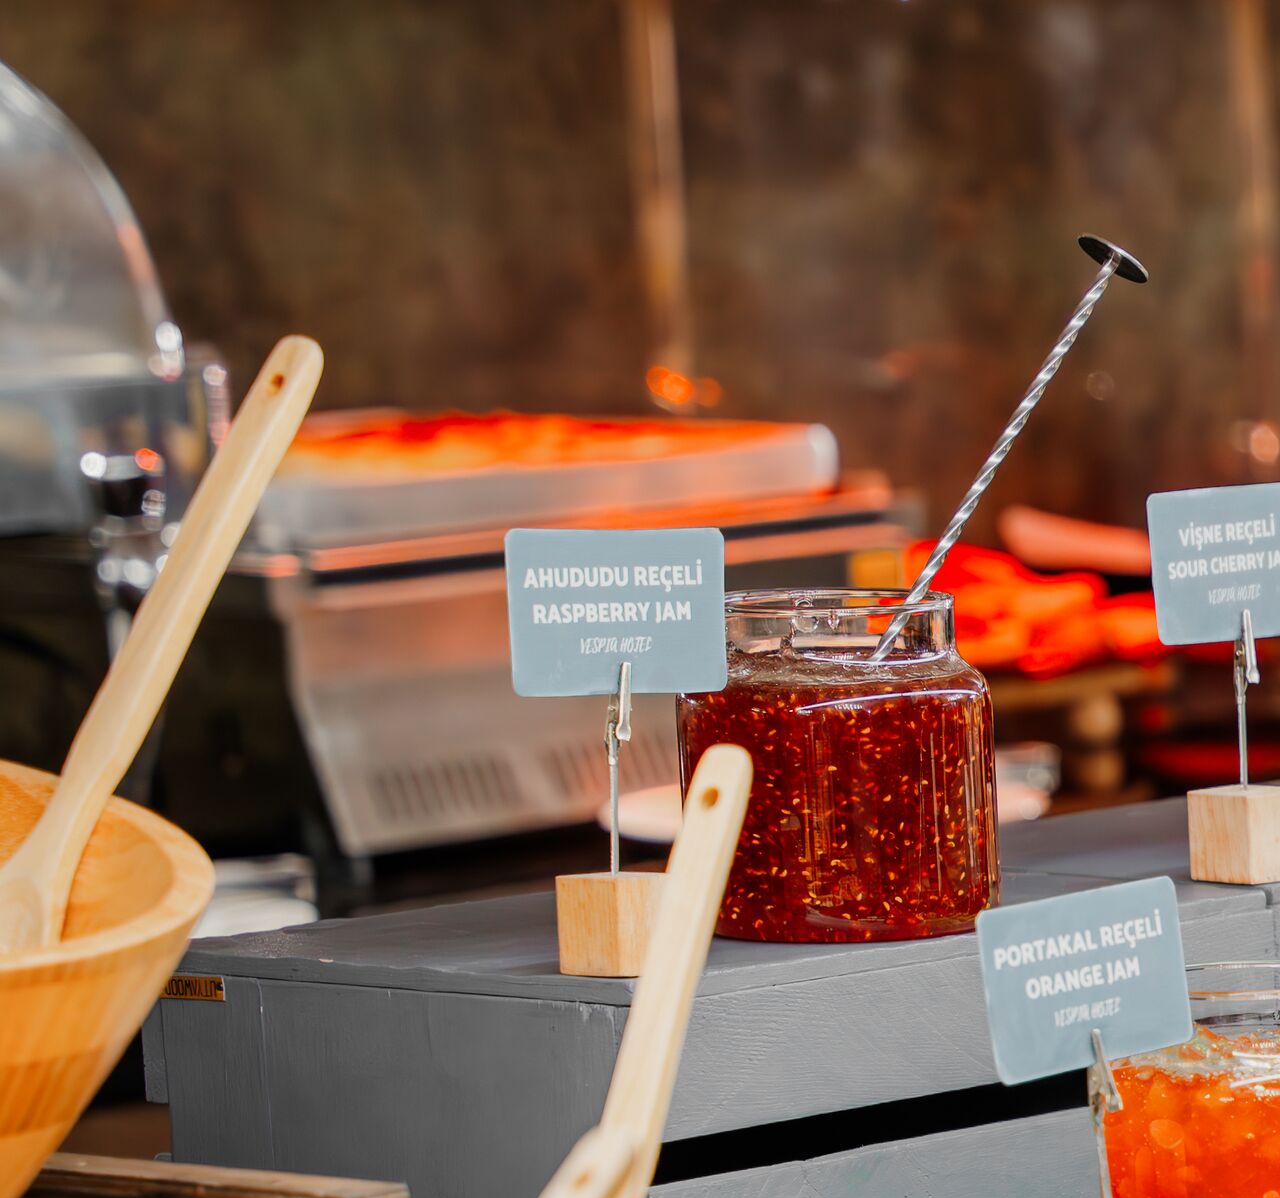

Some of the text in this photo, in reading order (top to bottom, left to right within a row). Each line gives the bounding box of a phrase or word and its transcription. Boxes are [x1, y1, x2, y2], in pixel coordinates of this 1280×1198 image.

[1179, 513, 1275, 551] VİŞNE REÇELİ
[523, 559, 703, 592] AHUDUDU REÇELİ
[1168, 559, 1208, 579] SOUR
[1211, 552, 1264, 575] CHERRY
[533, 601, 691, 624] RASPBERRY JAM
[993, 909, 1162, 970] PORTAKAL REÇELİ
[1025, 956, 1140, 999] ORANGE JAM
